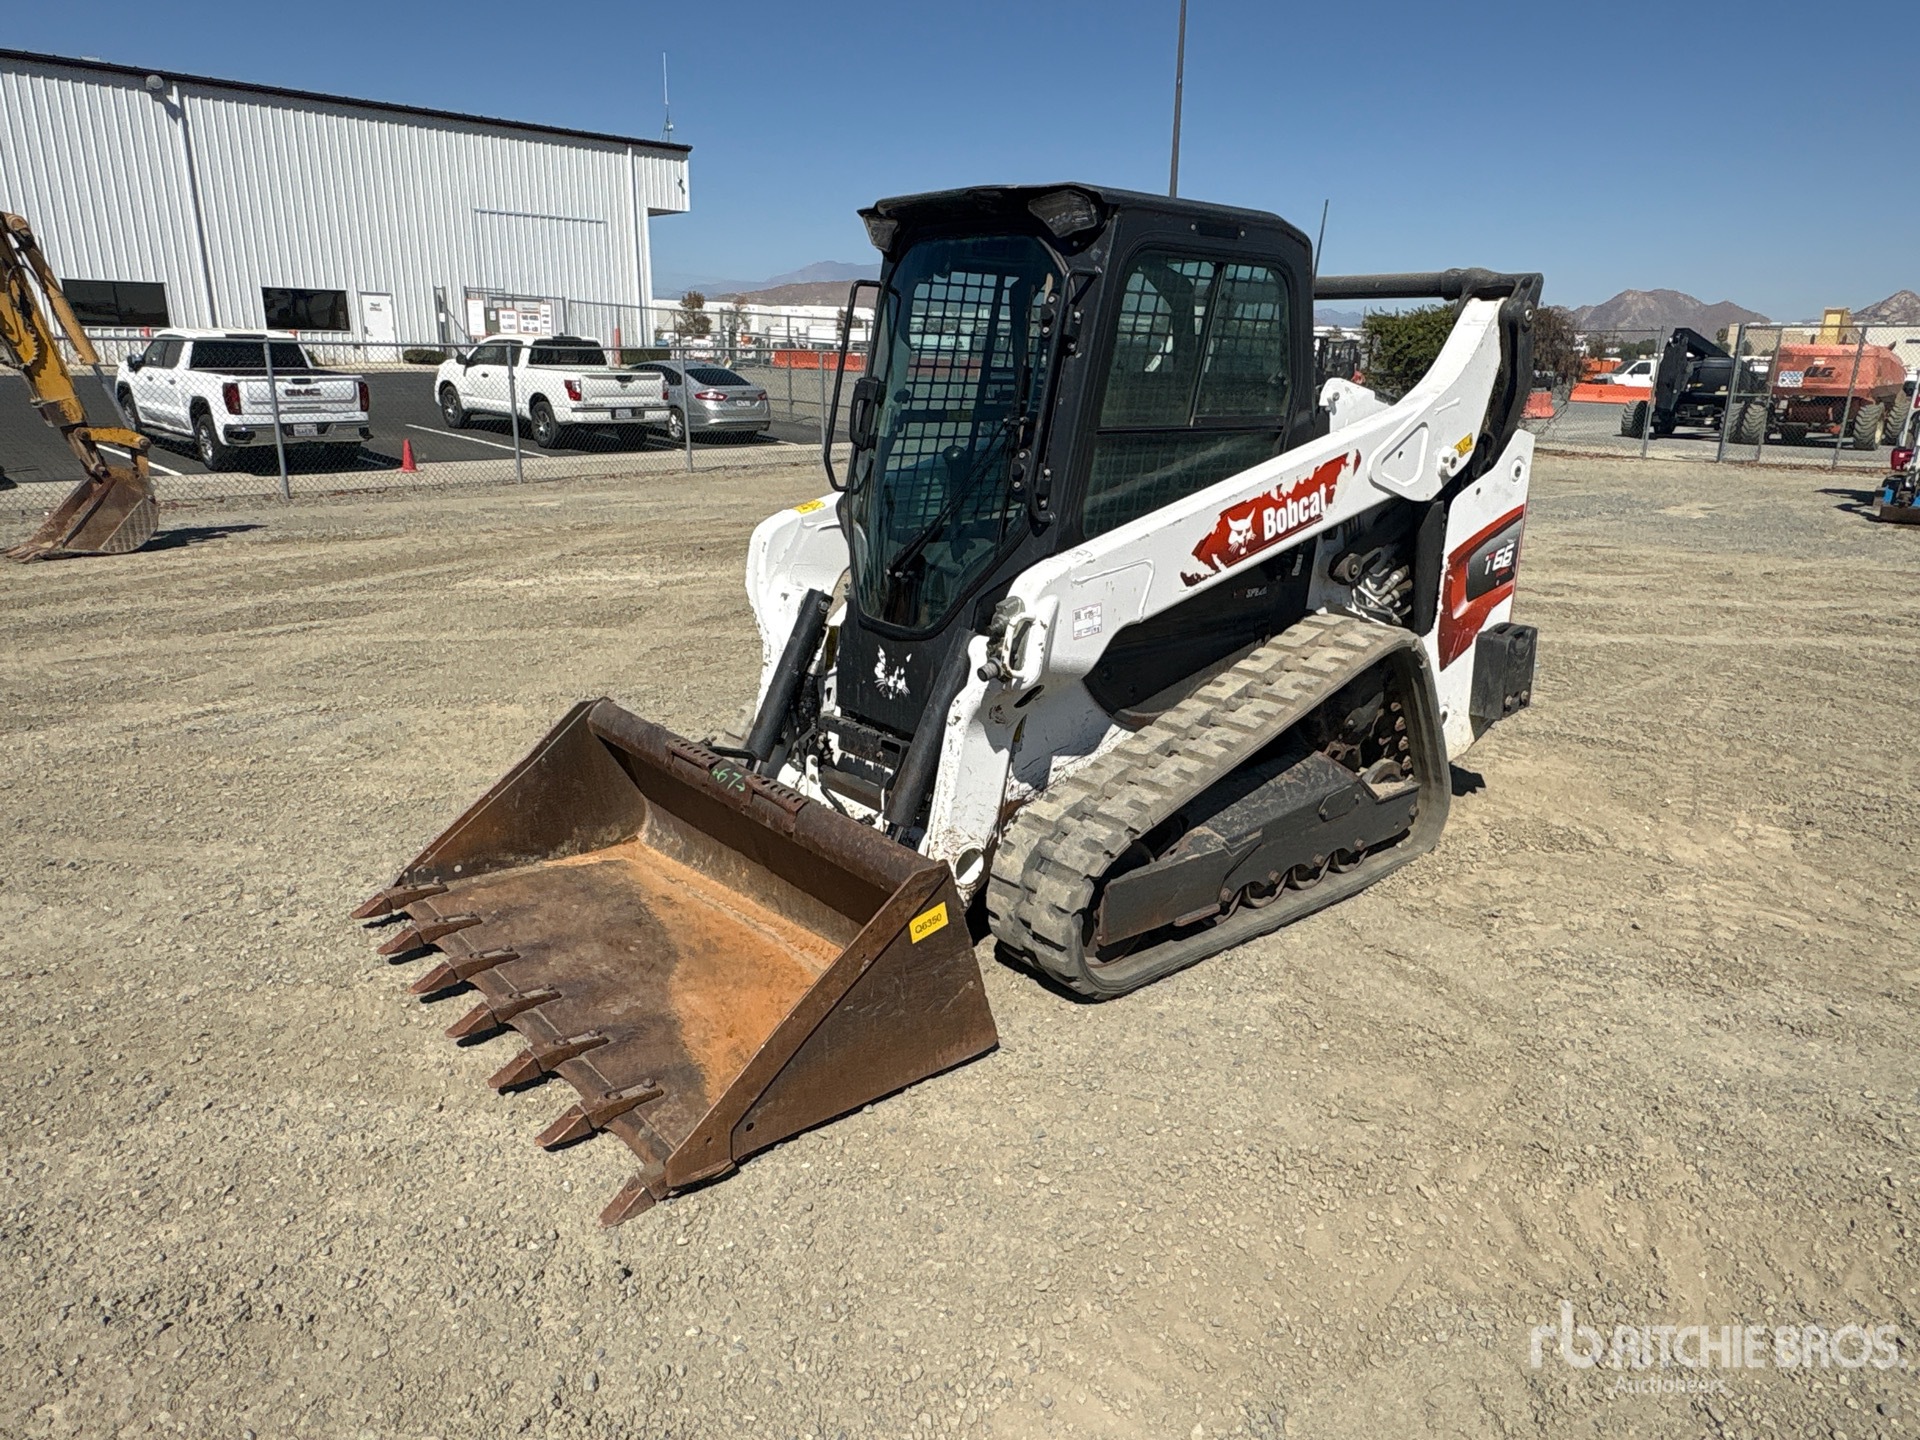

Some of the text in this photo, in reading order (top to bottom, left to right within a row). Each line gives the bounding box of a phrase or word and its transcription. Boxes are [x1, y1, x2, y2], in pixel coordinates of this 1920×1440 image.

[285, 388, 321, 397] GMC
[1262, 483, 1327, 541] Bobcat
[914, 912, 942, 934] Q6350
